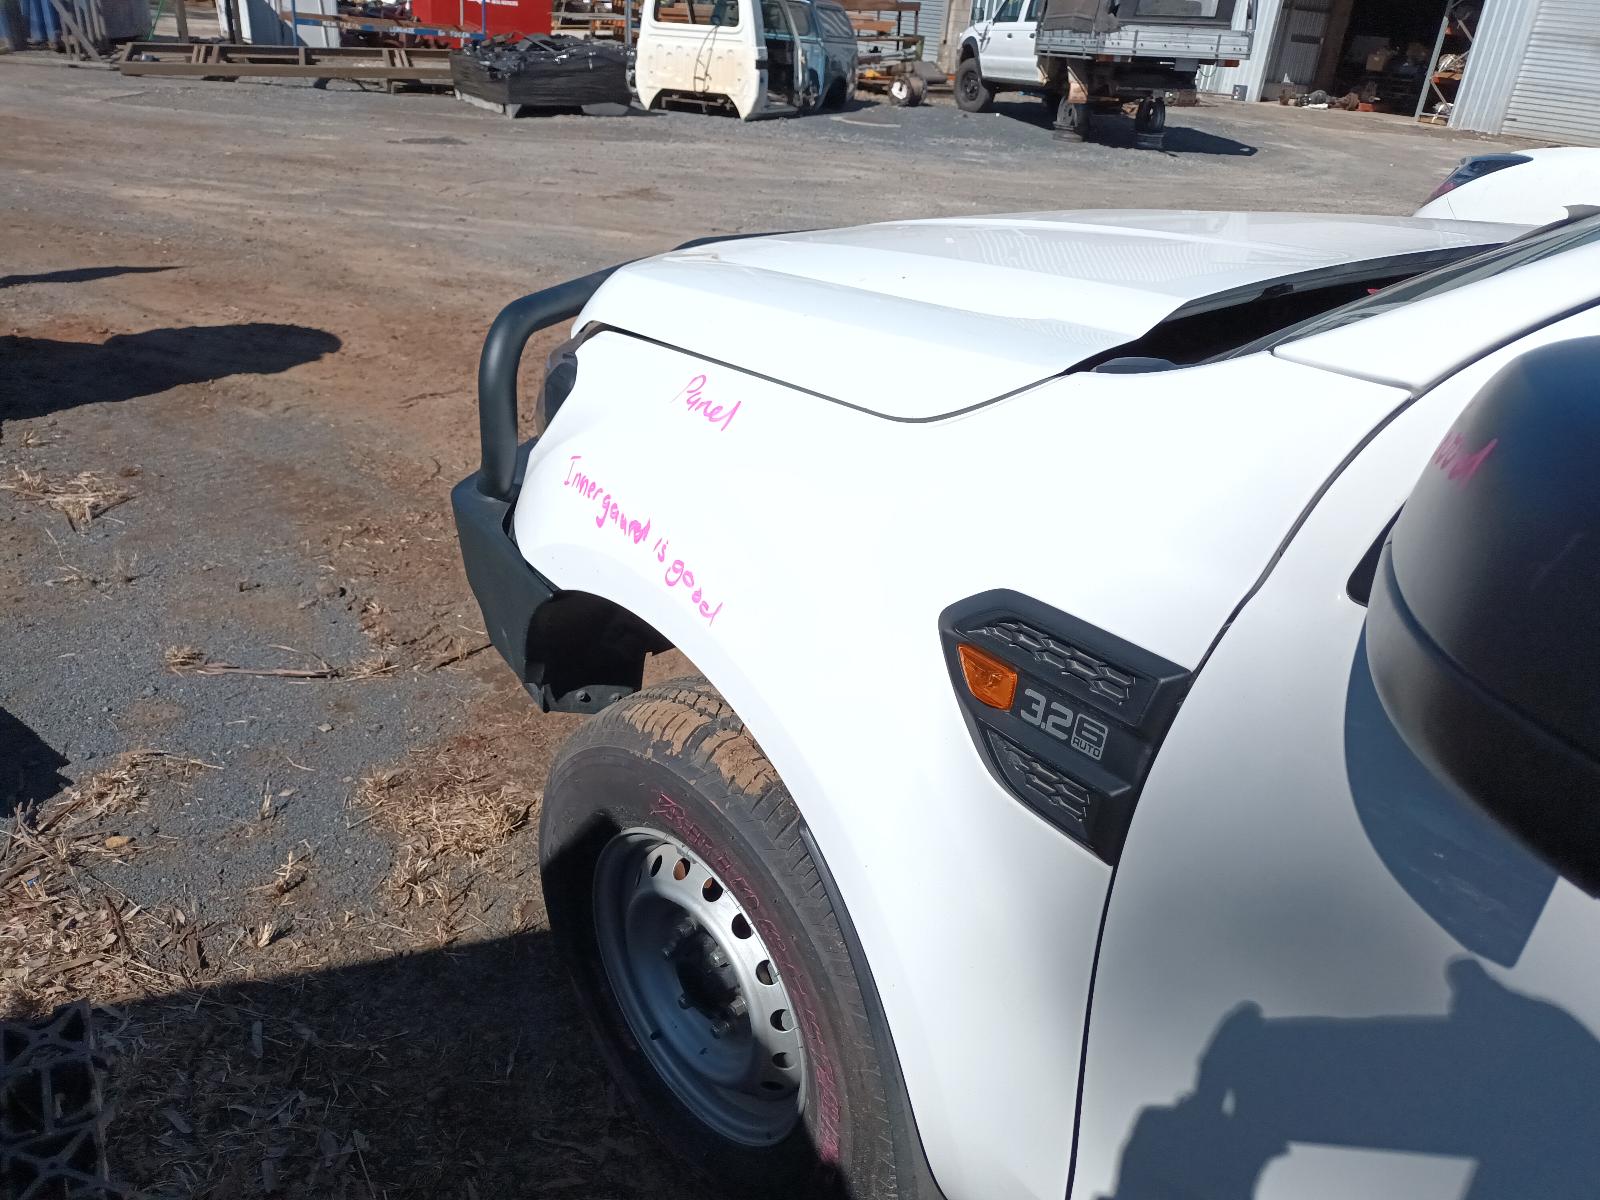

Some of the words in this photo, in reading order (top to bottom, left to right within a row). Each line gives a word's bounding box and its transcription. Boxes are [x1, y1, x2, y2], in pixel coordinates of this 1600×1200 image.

[670, 374, 742, 432] Panel
[653, 537, 669, 563] is
[665, 559, 723, 627] good
[1020, 688, 1074, 740] 3.2
[1072, 738, 1101, 759] AUTO
